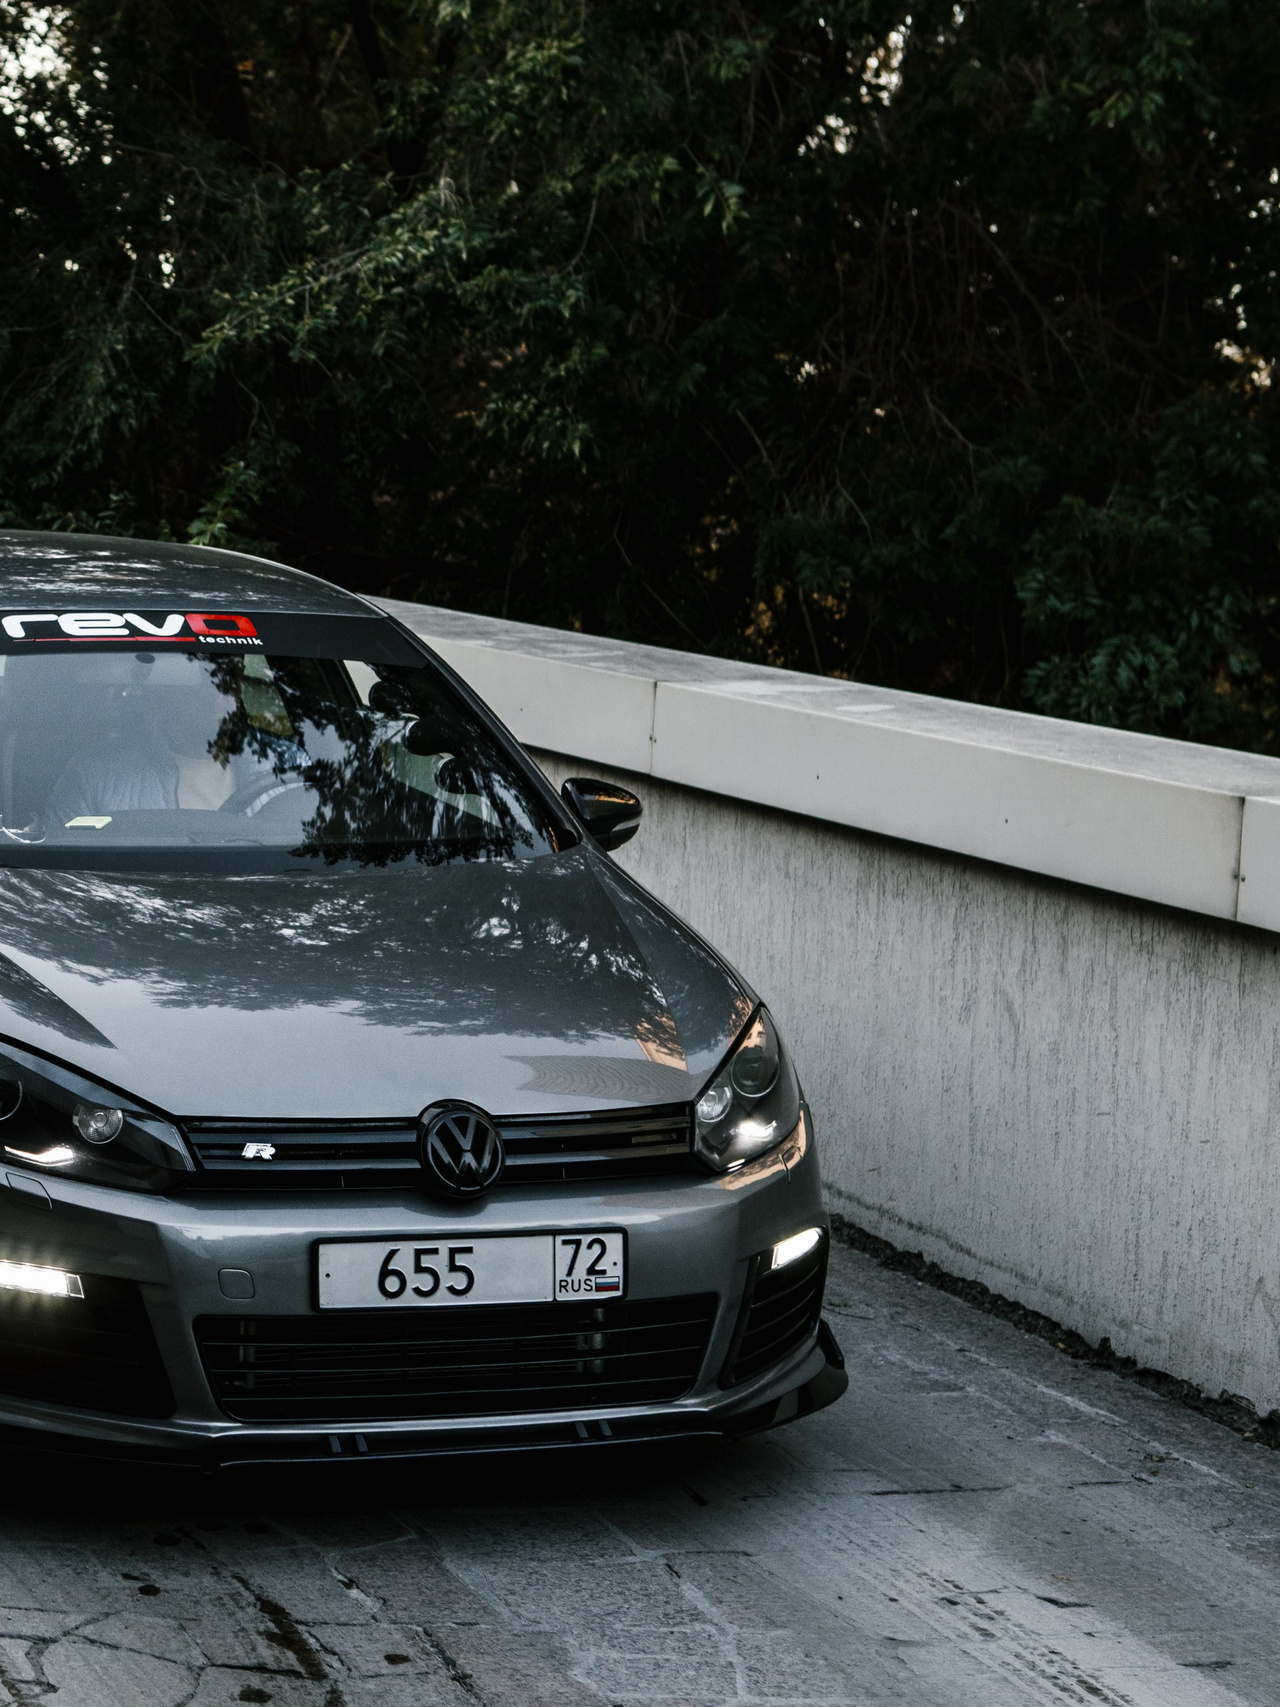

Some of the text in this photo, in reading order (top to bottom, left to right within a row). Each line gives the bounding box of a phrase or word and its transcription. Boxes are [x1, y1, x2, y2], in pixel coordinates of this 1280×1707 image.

[1, 613, 258, 638] revo
[198, 636, 263, 646] technik
[241, 1142, 276, 1160] R
[429, 1115, 497, 1184] VW
[378, 1237, 608, 1299] 655 72
[558, 1278, 594, 1293] RUS
